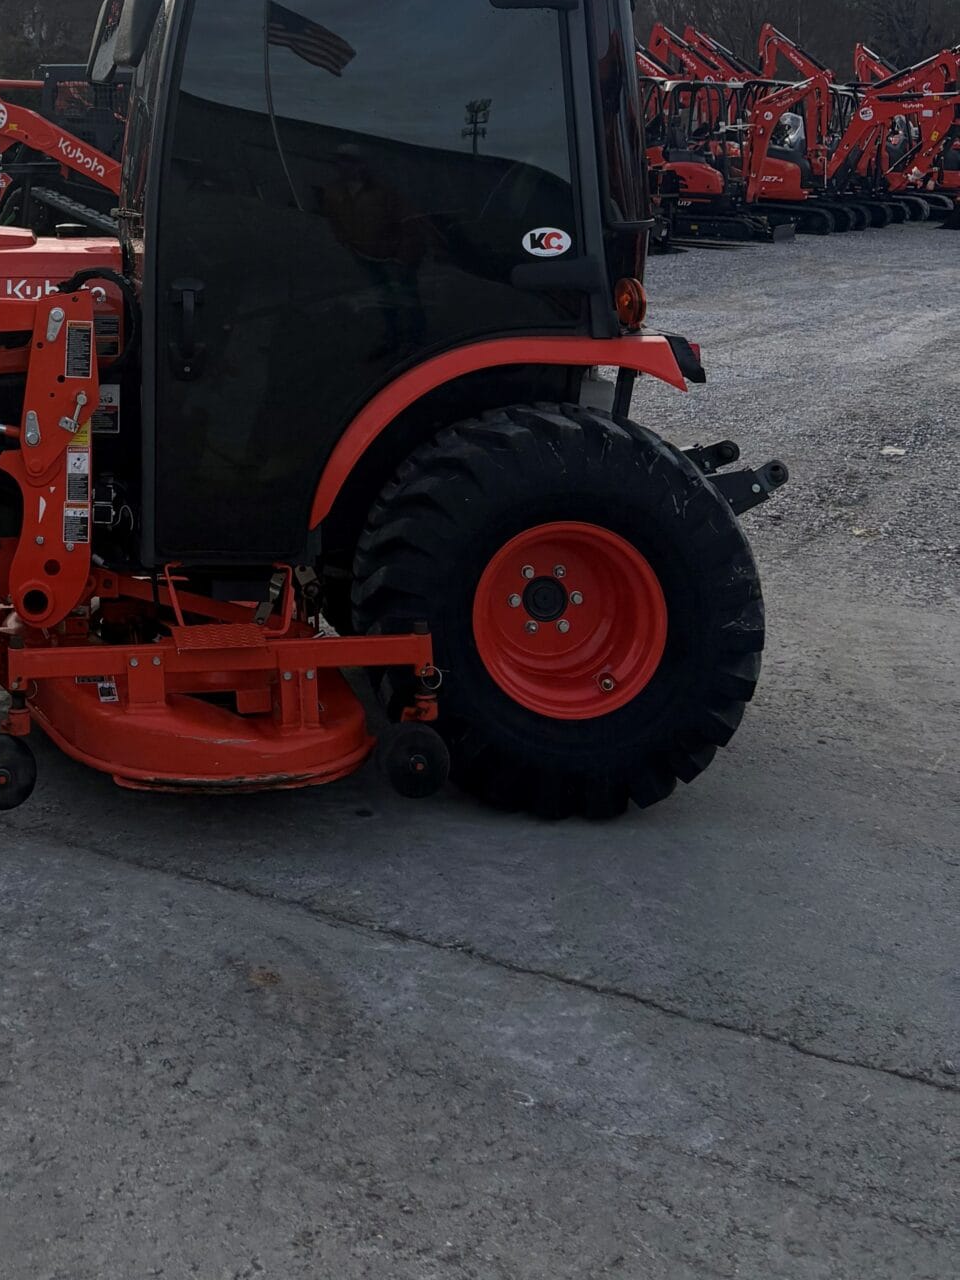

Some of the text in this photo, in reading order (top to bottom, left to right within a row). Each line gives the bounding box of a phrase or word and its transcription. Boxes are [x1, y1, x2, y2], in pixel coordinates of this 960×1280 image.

[57, 137, 105, 178] Kubota
[530, 231, 563, 250] KC
[6, 279, 107, 302] Kuba
